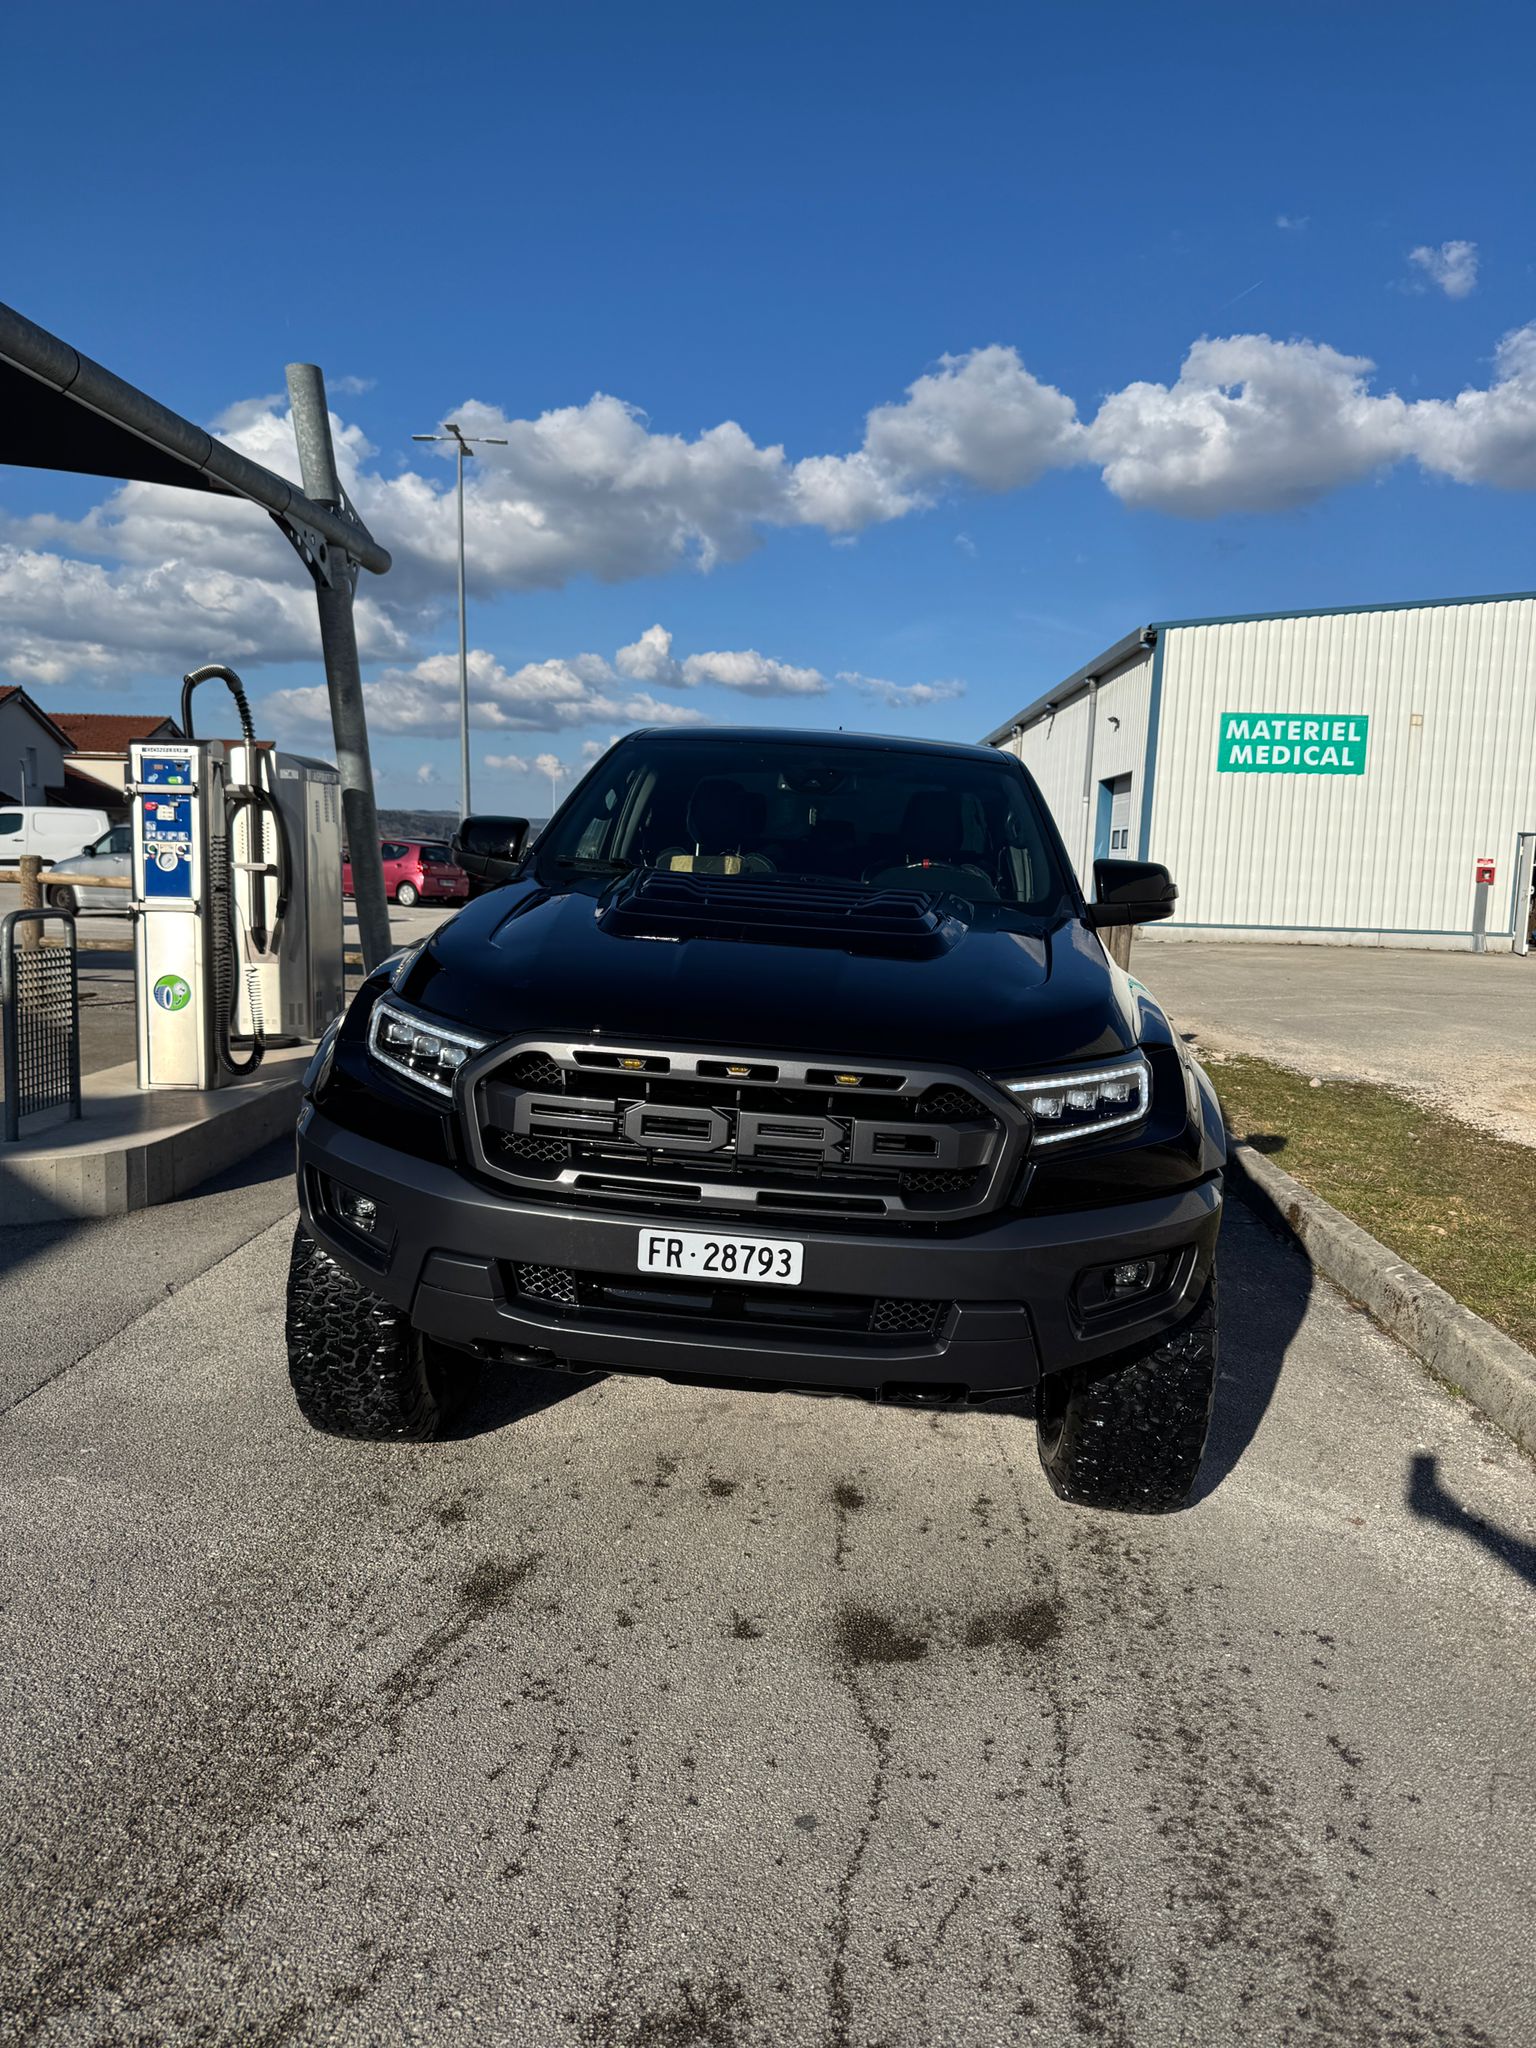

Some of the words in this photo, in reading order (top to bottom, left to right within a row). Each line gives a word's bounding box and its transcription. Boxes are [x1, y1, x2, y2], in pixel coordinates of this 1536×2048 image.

[1225, 719, 1362, 742] MATERIEL
[1229, 745, 1355, 766] MEDICAL
[512, 1090, 980, 1169] FORD
[702, 1242, 792, 1278] 28793
